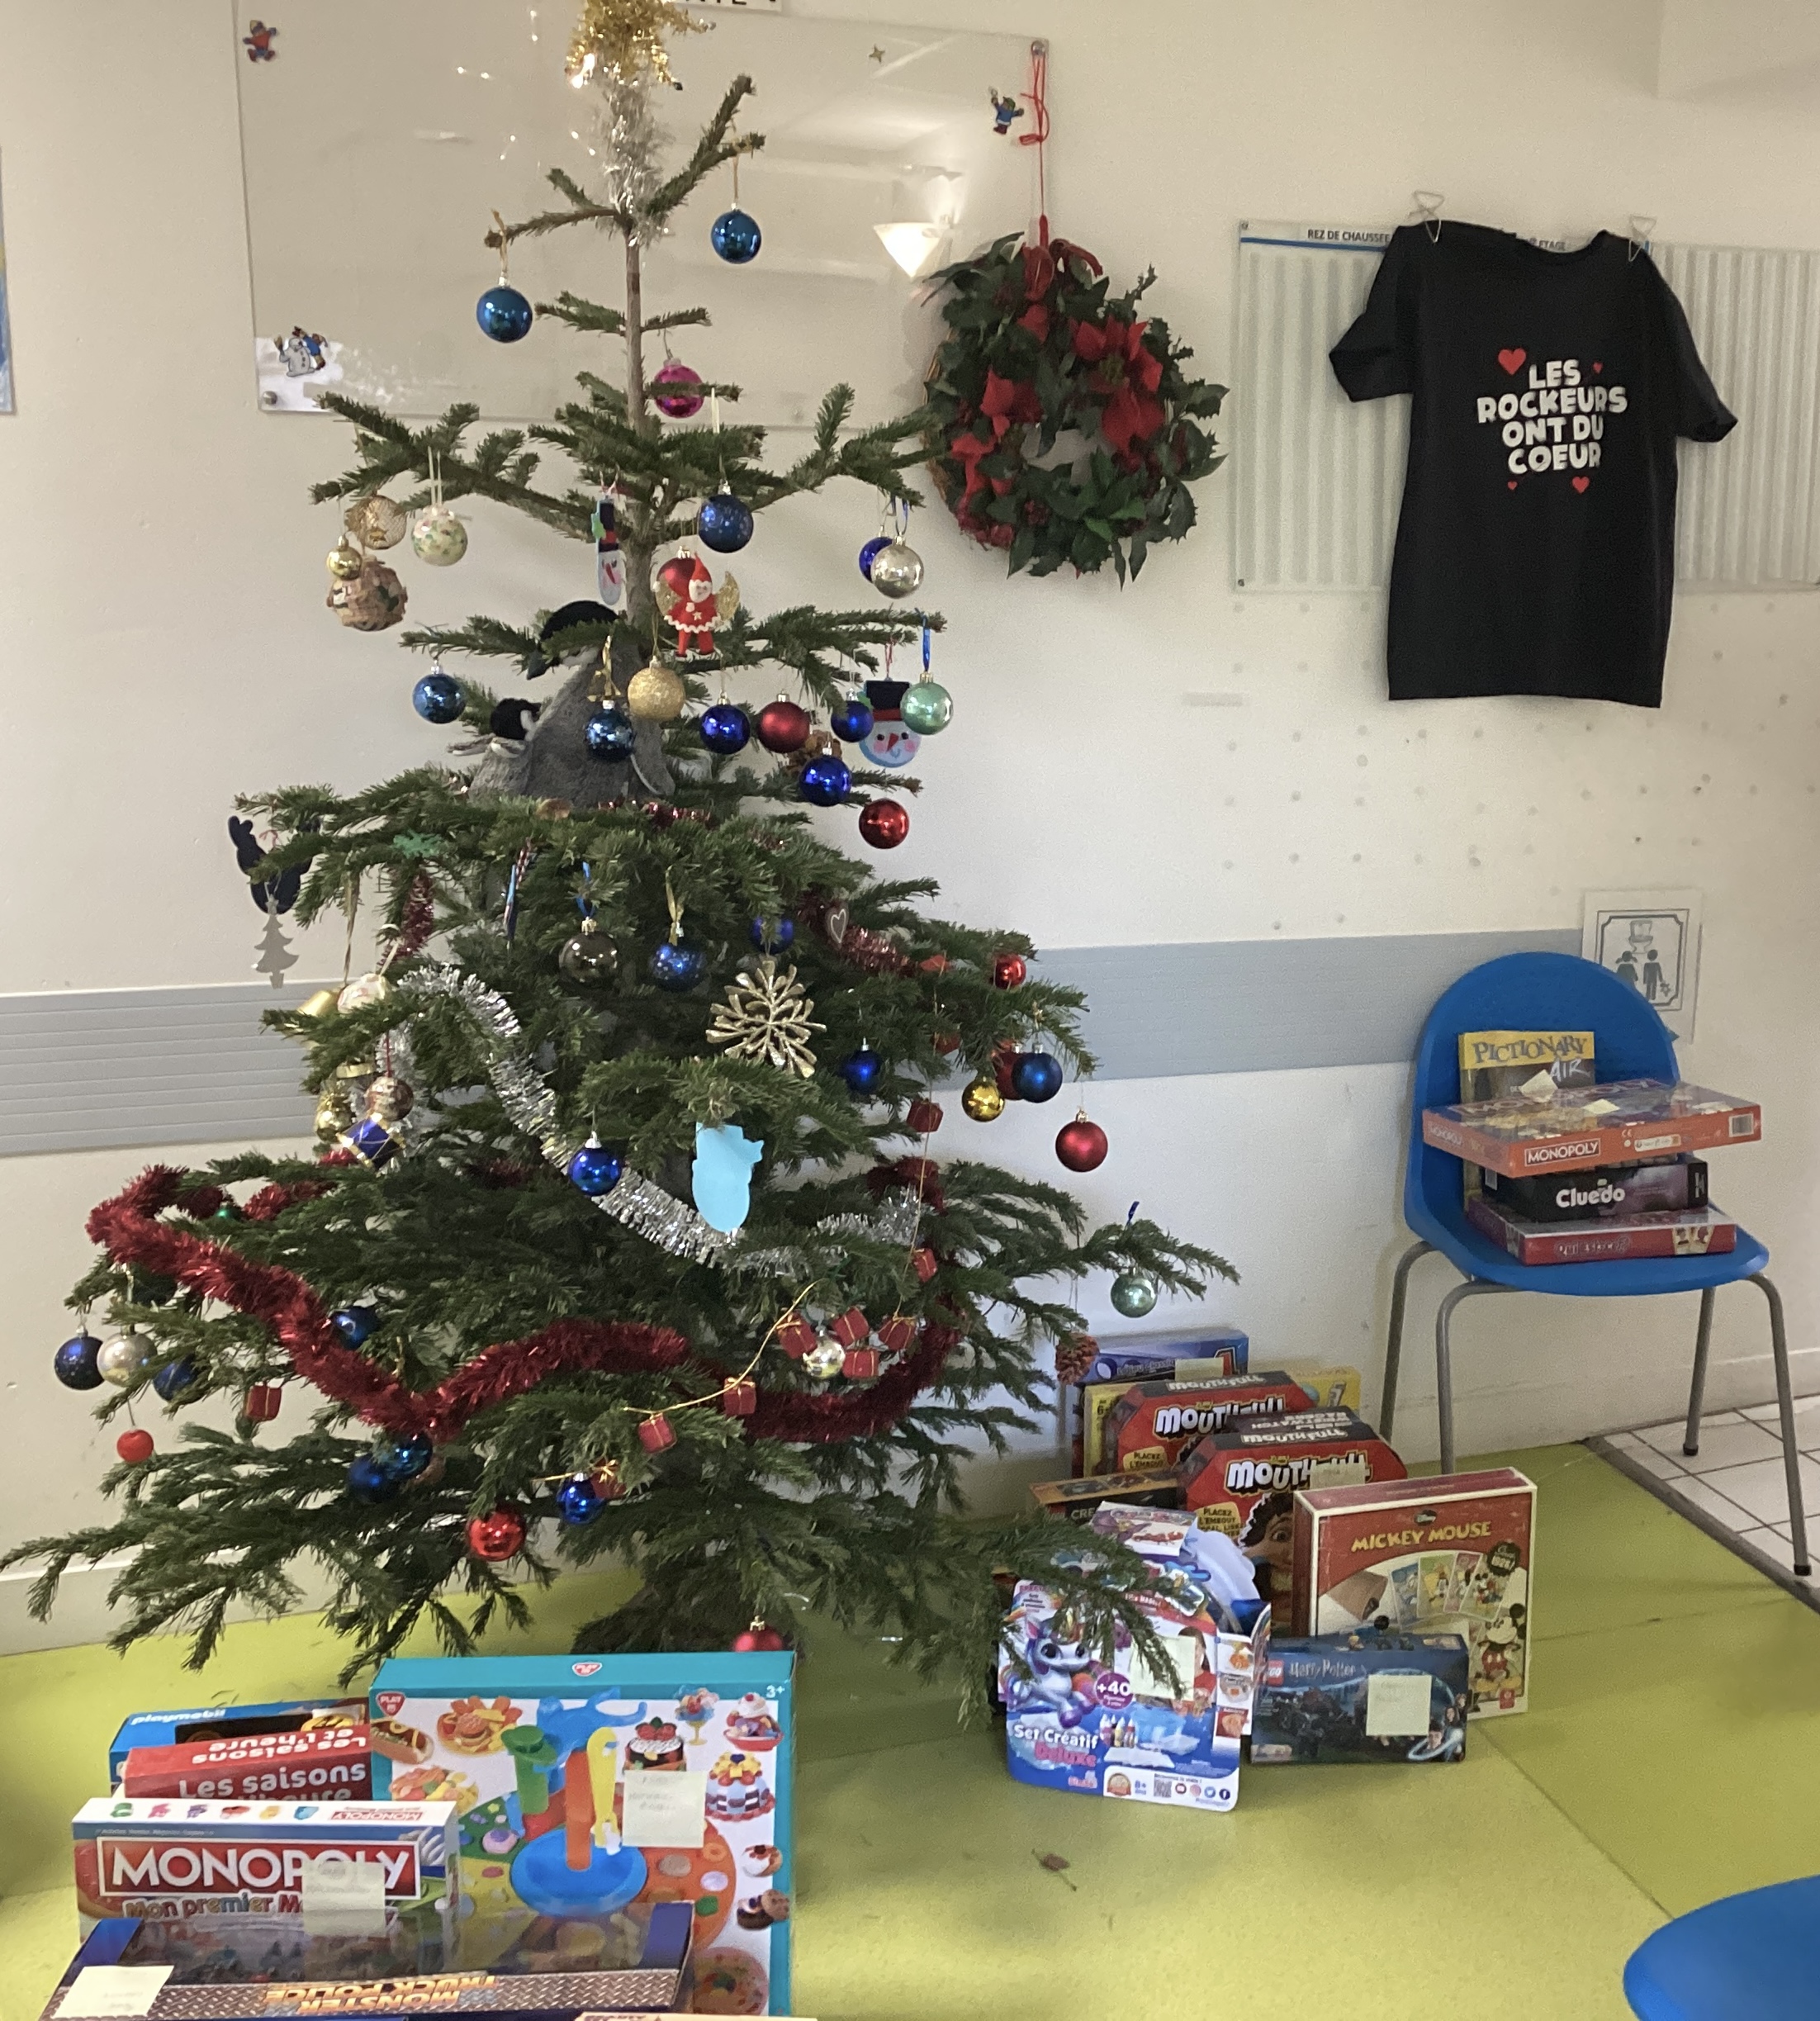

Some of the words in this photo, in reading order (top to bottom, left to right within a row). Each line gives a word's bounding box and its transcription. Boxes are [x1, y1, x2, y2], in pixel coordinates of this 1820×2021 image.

[1307, 229, 1325, 240] REZ
[1328, 230, 1339, 240] DE
[1529, 358, 1581, 390] LES
[1476, 386, 1628, 424] ROCKEURS
[1501, 416, 1567, 448] ONT
[1572, 414, 1604, 441] DU
[1508, 441, 1602, 475] COEUR
[1472, 1034, 1587, 1065] PICTIONARY
[1548, 1058, 1591, 1082] AIR
[1528, 1141, 1599, 1164] MONOPOLY
[1556, 1184, 1626, 1208] Cluedo
[1070, 1507, 1096, 1520] CRE
[1351, 1530, 1424, 1553] MICKEY
[1428, 1520, 1491, 1543] MOUSE
[1289, 1661, 1321, 1680] Harry
[766, 1685, 785, 1698] 3+
[1097, 1681, 1130, 1696] +40
[130, 1708, 226, 1725] playmobil
[209, 1732, 316, 1752] l'heure
[317, 1736, 367, 1750] Les
[329, 1729, 354, 1739] et
[192, 1743, 309, 1764] saisons
[179, 1777, 235, 1799] Les
[243, 1763, 367, 1794] saisons
[332, 1810, 422, 1821] MONOPOLY
[112, 1847, 410, 1890] MONOPY
[126, 1900, 178, 1919] Mon
[182, 1891, 274, 1919] premier
[277, 1893, 303, 1914] M
[264, 1983, 383, 2004] POLICE
[393, 1975, 496, 1992] TRUCK
[296, 1990, 461, 2016] MONSTER
